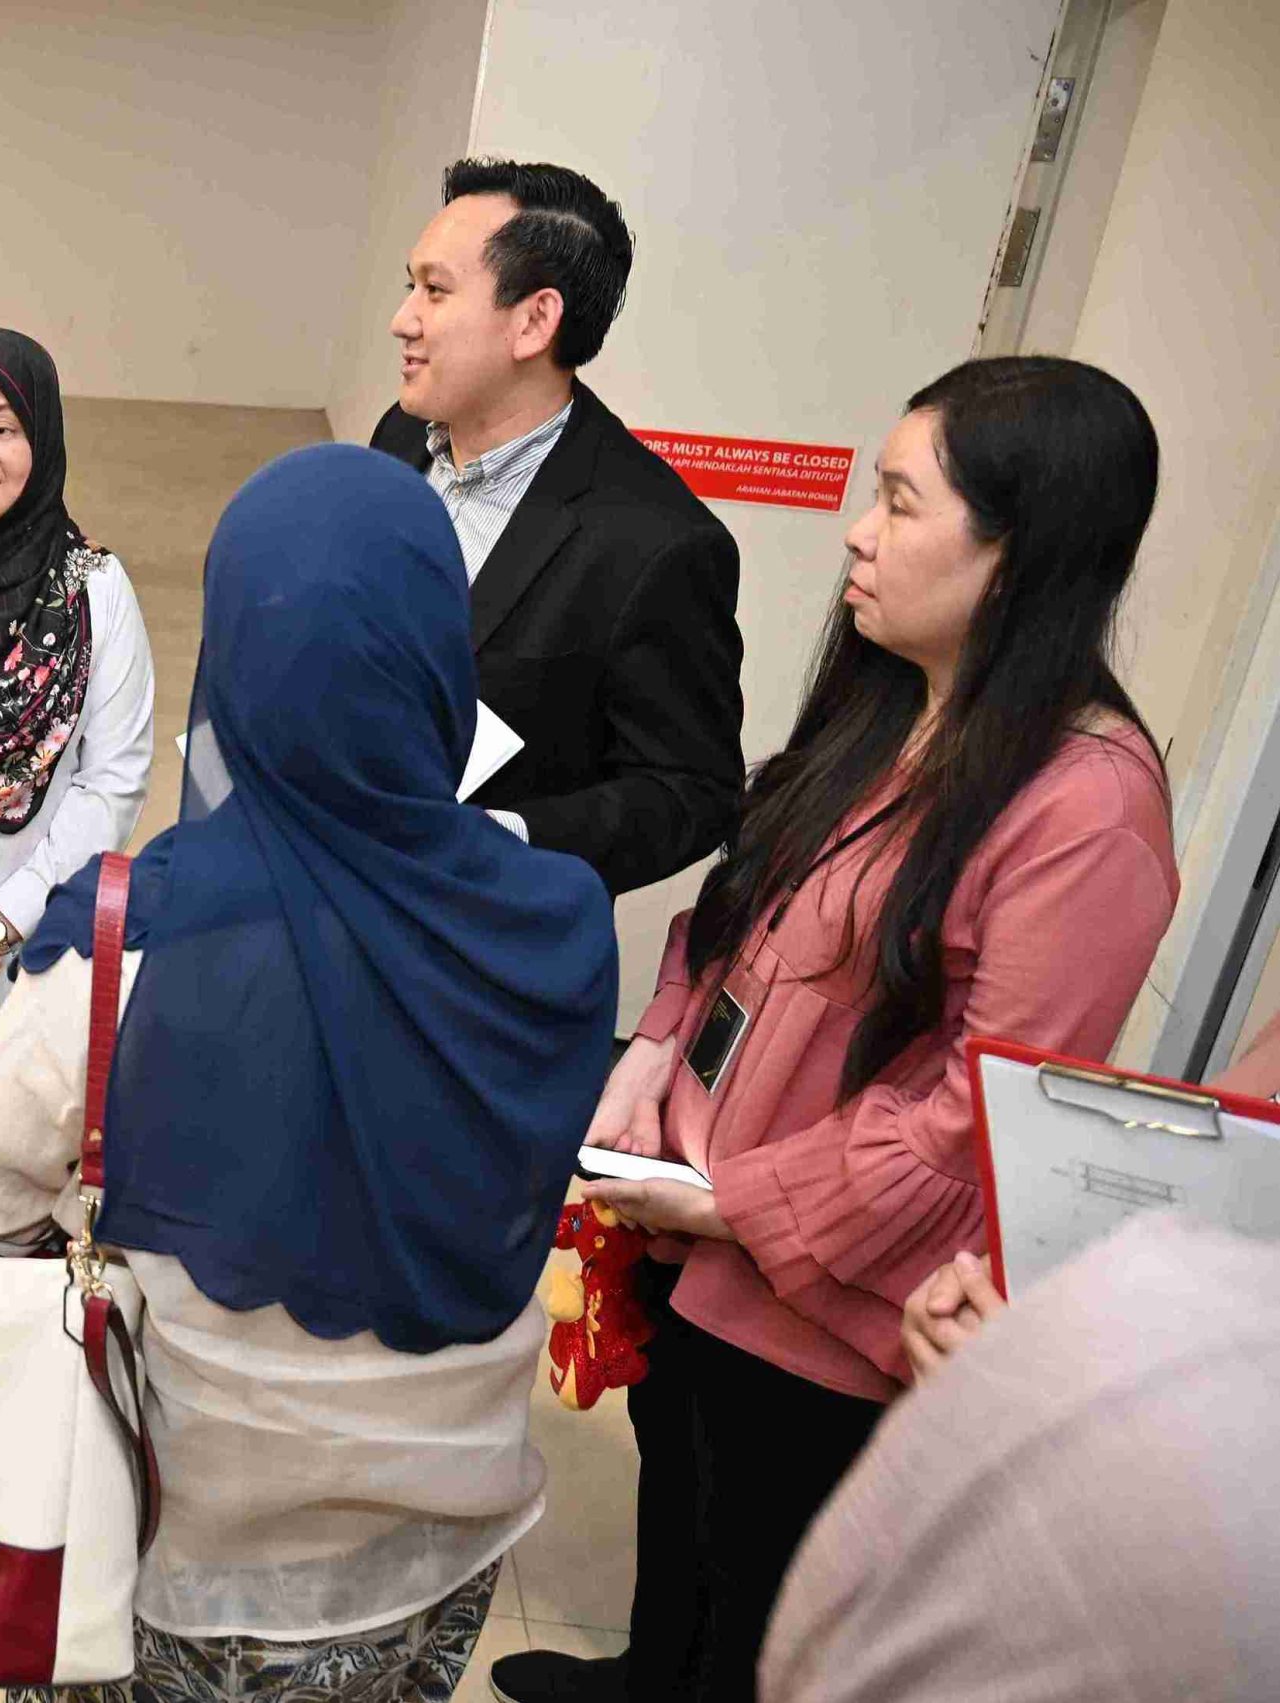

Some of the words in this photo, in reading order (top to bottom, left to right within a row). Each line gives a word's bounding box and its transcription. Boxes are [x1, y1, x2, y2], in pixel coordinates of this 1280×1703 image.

[640, 439, 670, 454] ORS
[672, 442, 713, 457] MUST
[714, 446, 770, 463] ALWAYS
[772, 451, 792, 465] BE
[793, 453, 850, 470] CLOSED
[674, 457, 691, 469] API
[690, 459, 752, 474] HENDAKLAH
[752, 465, 799, 478] SENTIASA
[799, 469, 845, 482] DITUTUP
[736, 484, 771, 496] ARAHAN
[771, 487, 808, 499] JABATAN
[808, 491, 839, 503] BOMBA
